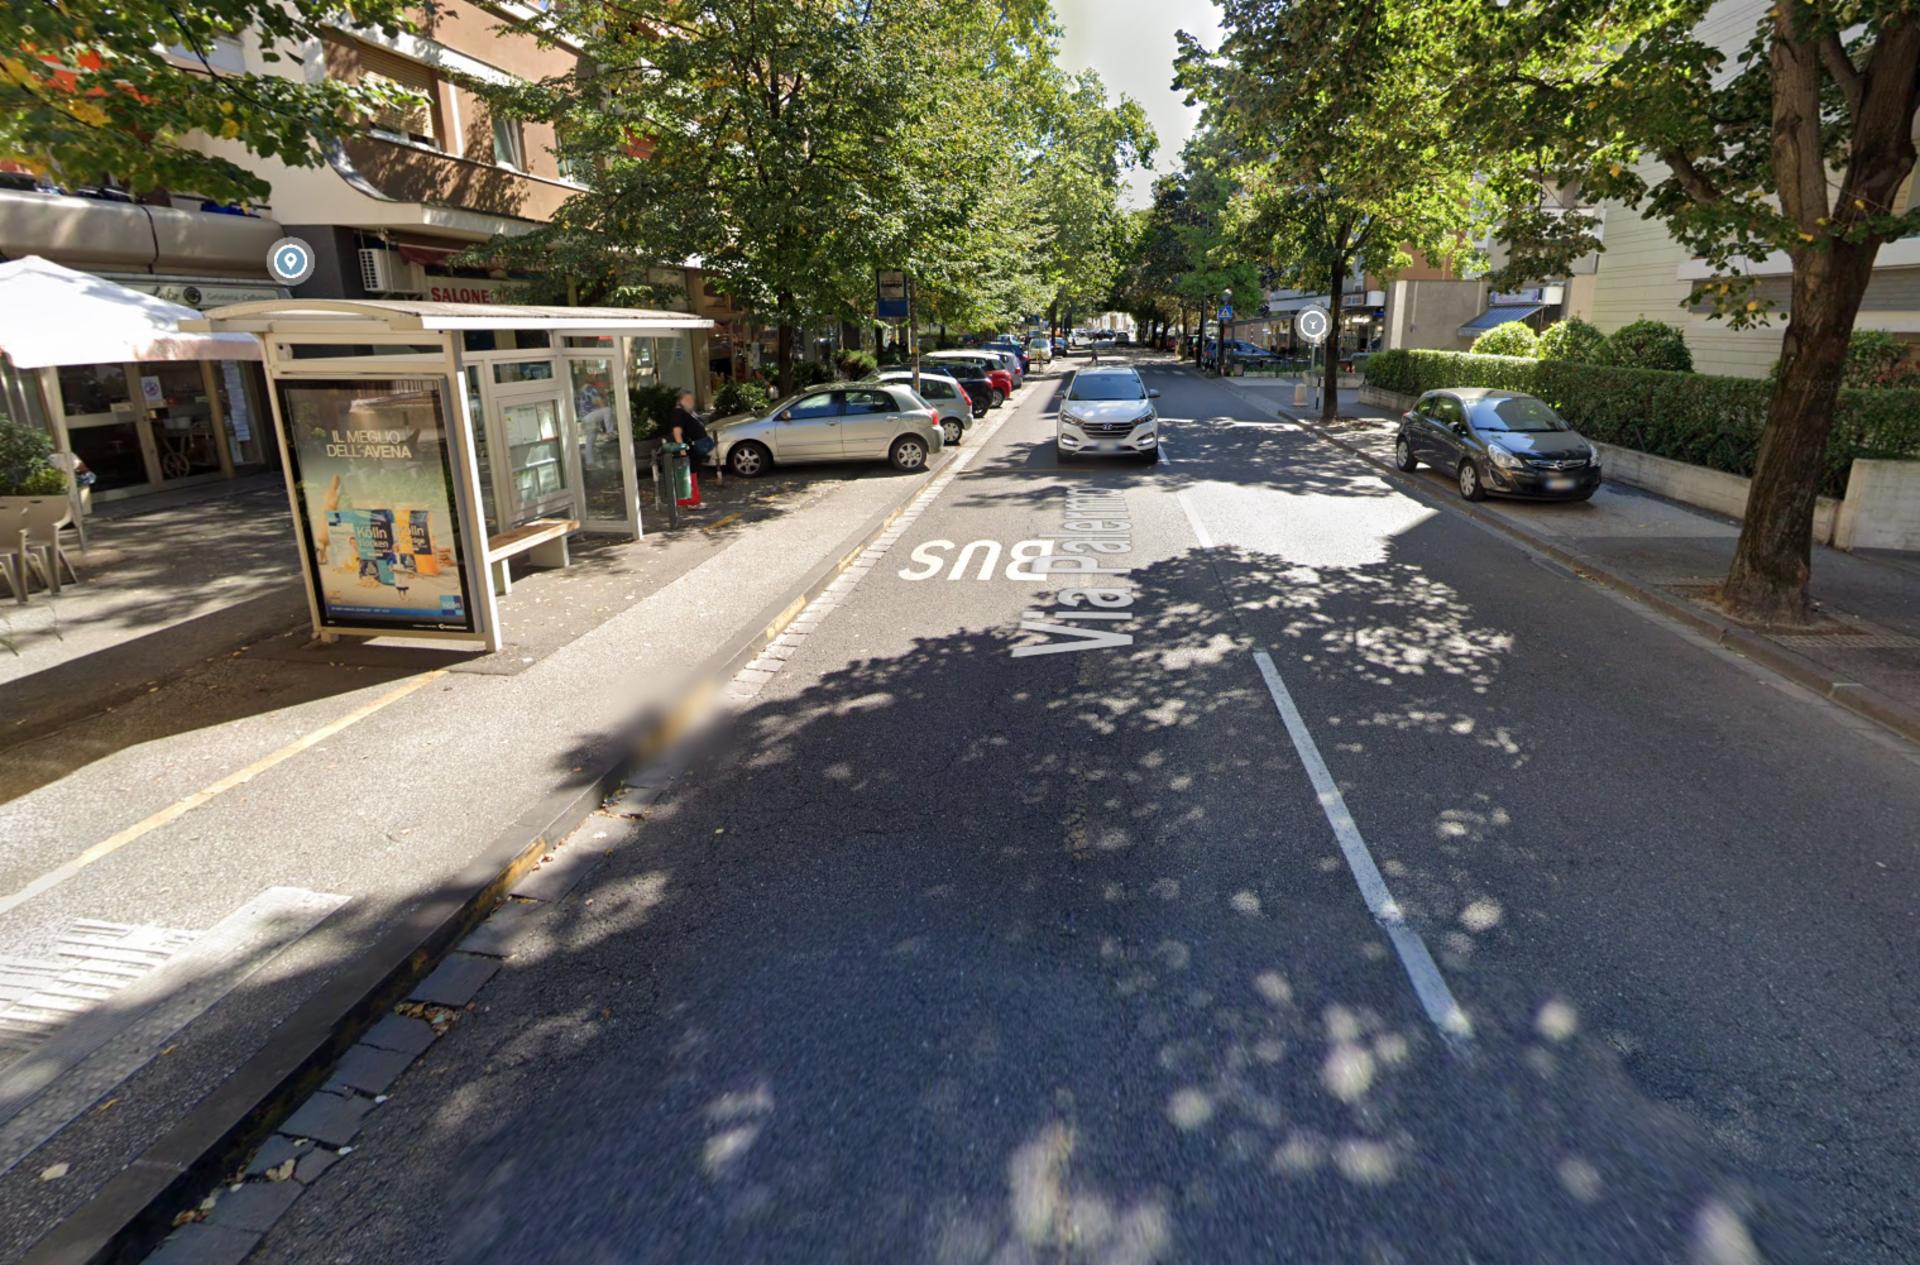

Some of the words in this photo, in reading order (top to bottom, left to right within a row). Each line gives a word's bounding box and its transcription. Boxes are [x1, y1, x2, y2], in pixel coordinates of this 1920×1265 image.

[431, 287, 490, 304] SALONE
[331, 430, 345, 443] IL
[346, 430, 400, 444] MEGLIO
[326, 444, 412, 458] DELL'AVENA
[899, 539, 1055, 581] BUS
